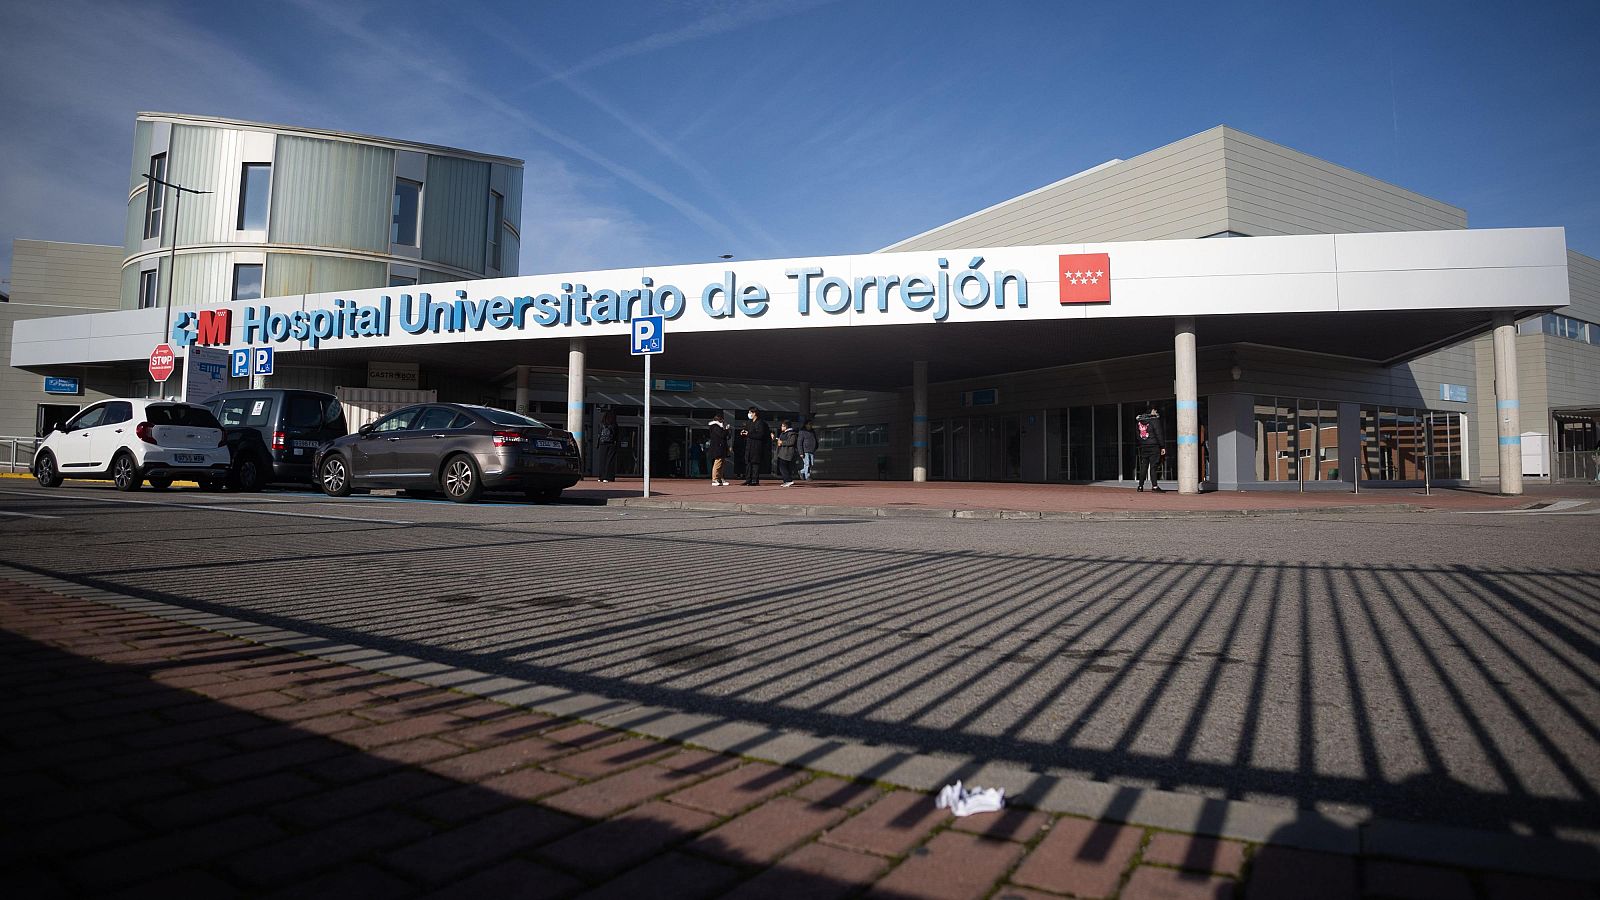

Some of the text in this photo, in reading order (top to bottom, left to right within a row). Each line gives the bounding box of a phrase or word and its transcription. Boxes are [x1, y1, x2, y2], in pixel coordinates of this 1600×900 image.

[242, 256, 1028, 349] Hospital Universitario de Torrejón
[634, 320, 655, 350] P
[235, 352, 247, 374] P
[256, 350, 268, 372] P
